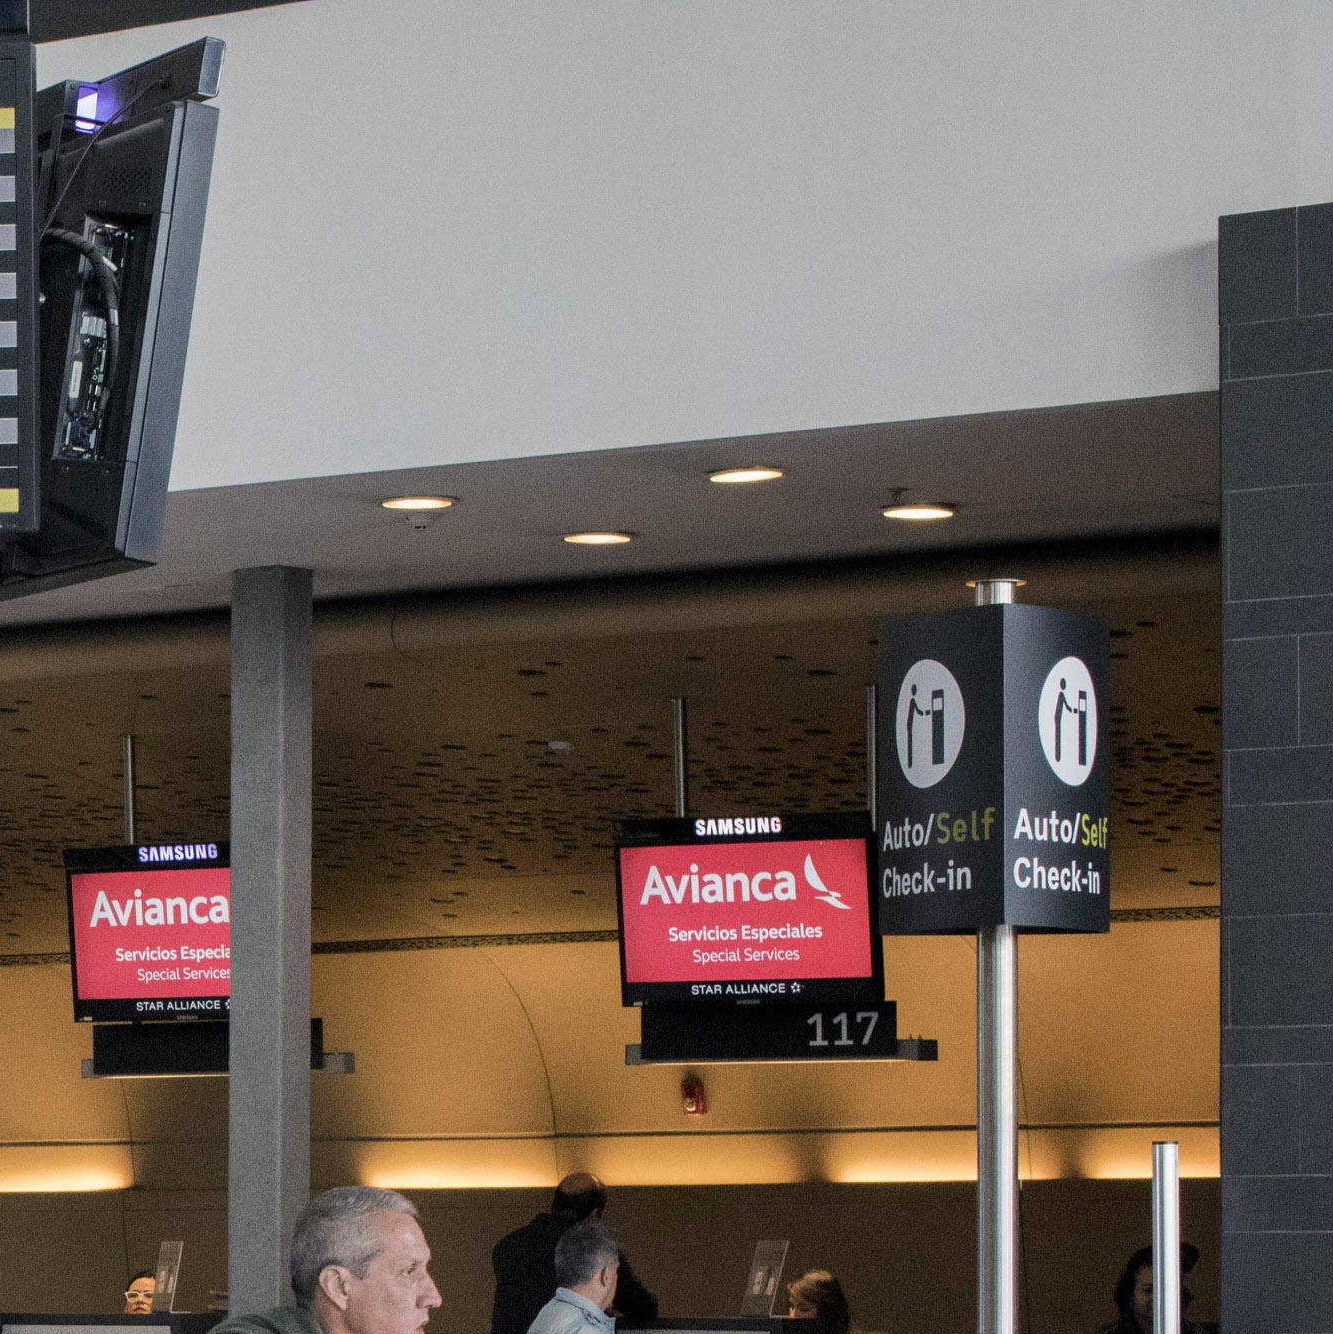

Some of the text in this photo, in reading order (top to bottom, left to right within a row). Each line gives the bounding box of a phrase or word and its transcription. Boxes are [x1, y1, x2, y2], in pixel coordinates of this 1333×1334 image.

[695, 816, 782, 836] SAMSUNG
[883, 807, 996, 851] Auto/Self
[1013, 808, 1108, 849] Auto/Self
[138, 843, 218, 862] SAMSUNG
[640, 863, 797, 905] Avianca
[883, 859, 972, 898] Check-in
[1013, 857, 1101, 895] Check-in
[89, 889, 230, 928] Avianca
[668, 923, 823, 943] Servicios Especiales
[115, 947, 177, 962] Servicios
[693, 947, 800, 966] Special Services
[137, 967, 180, 984] Special
[691, 983, 786, 995] STAR ALLIANCE
[136, 1000, 221, 1011] STAR ALLIANCE
[807, 1012, 879, 1046] 117
